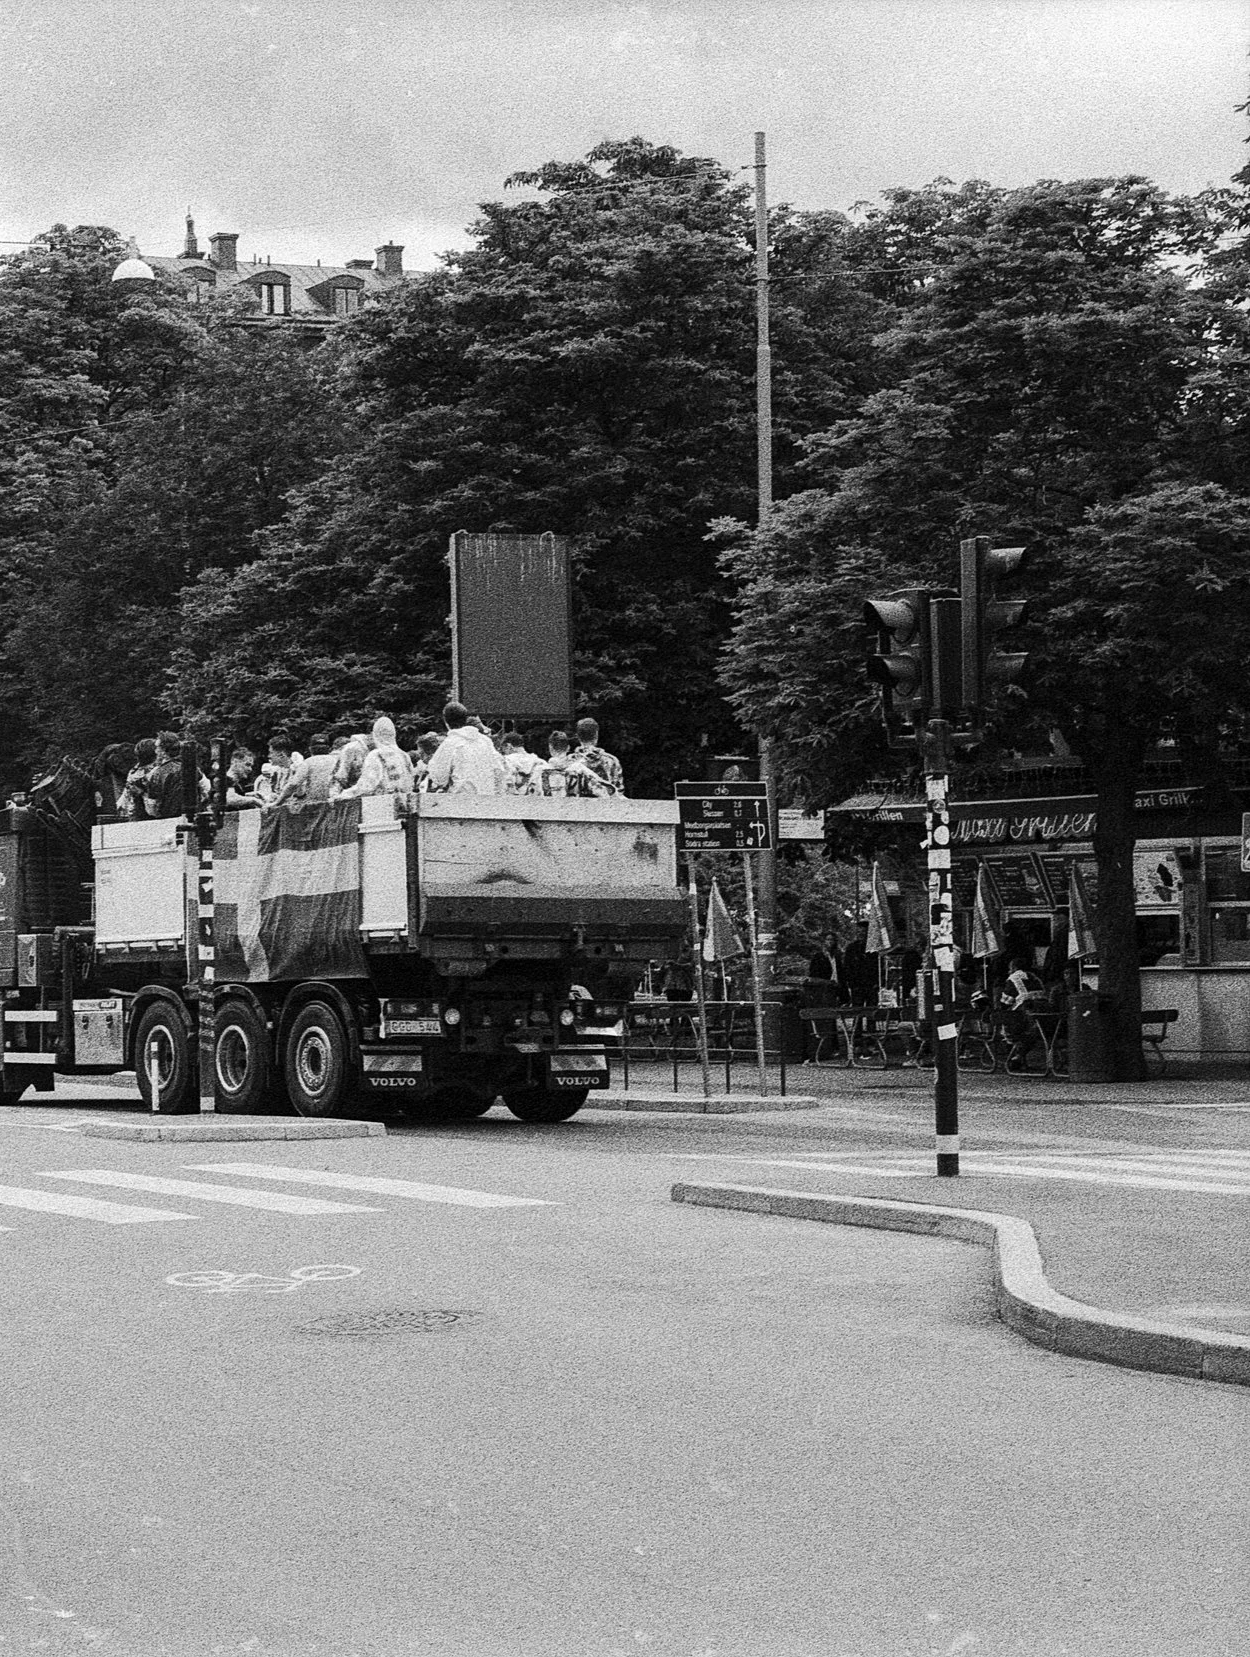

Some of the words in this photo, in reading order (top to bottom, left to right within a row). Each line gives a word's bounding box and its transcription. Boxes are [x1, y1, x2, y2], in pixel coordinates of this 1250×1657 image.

[1134, 794, 1155, 808] axi
[684, 830, 709, 838] Hornstull
[950, 817, 1006, 842] Maxi
[702, 839, 720, 847] station
[369, 1077, 417, 1087] VOLVO
[557, 1076, 600, 1086] VOLVO
